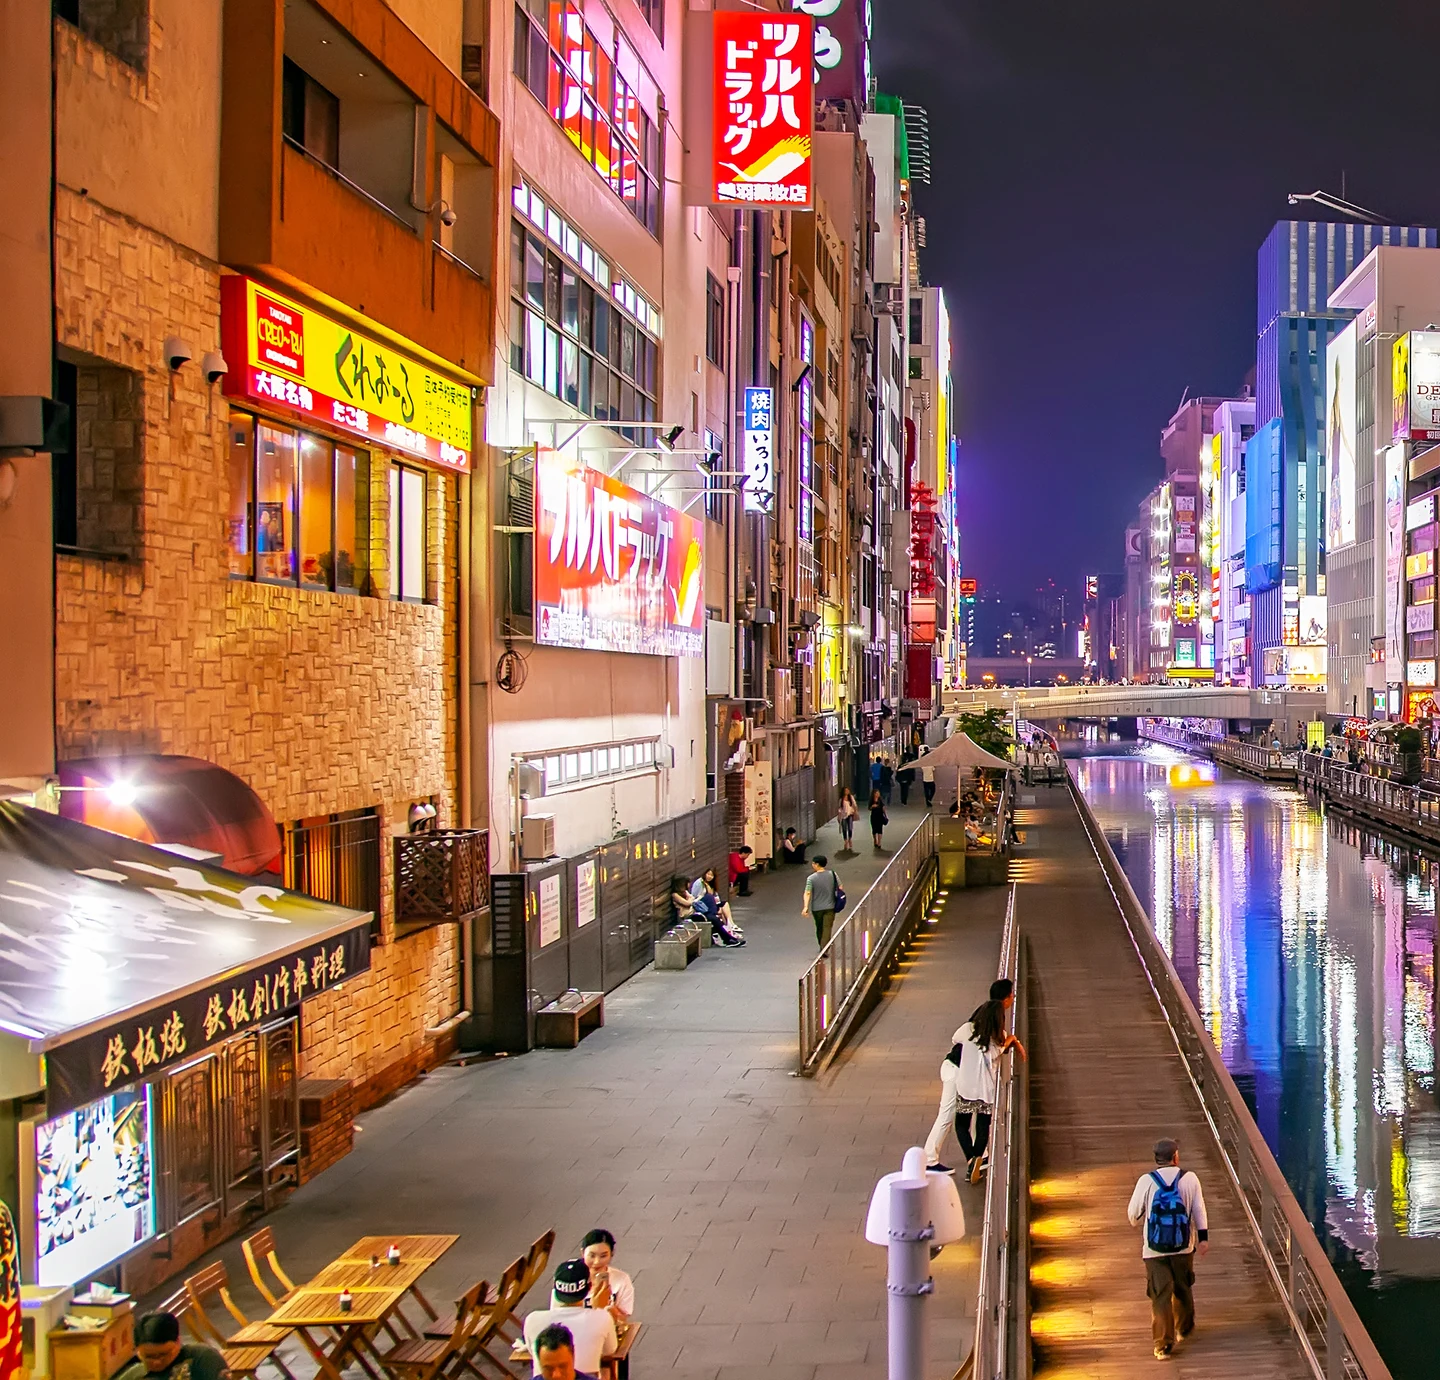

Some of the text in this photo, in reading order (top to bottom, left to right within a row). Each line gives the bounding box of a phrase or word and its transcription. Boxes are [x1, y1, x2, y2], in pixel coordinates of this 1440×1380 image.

[723, 40, 758, 156] ドラッグ
[760, 22, 801, 129] ツルハ
[255, 371, 313, 411] 大阪名物
[332, 400, 369, 432] たこ焼
[335, 333, 414, 423] くれおーる
[751, 391, 771, 429] 焼肉
[101, 944, 346, 1088] 鉄板焼 鉄板創作串料理
